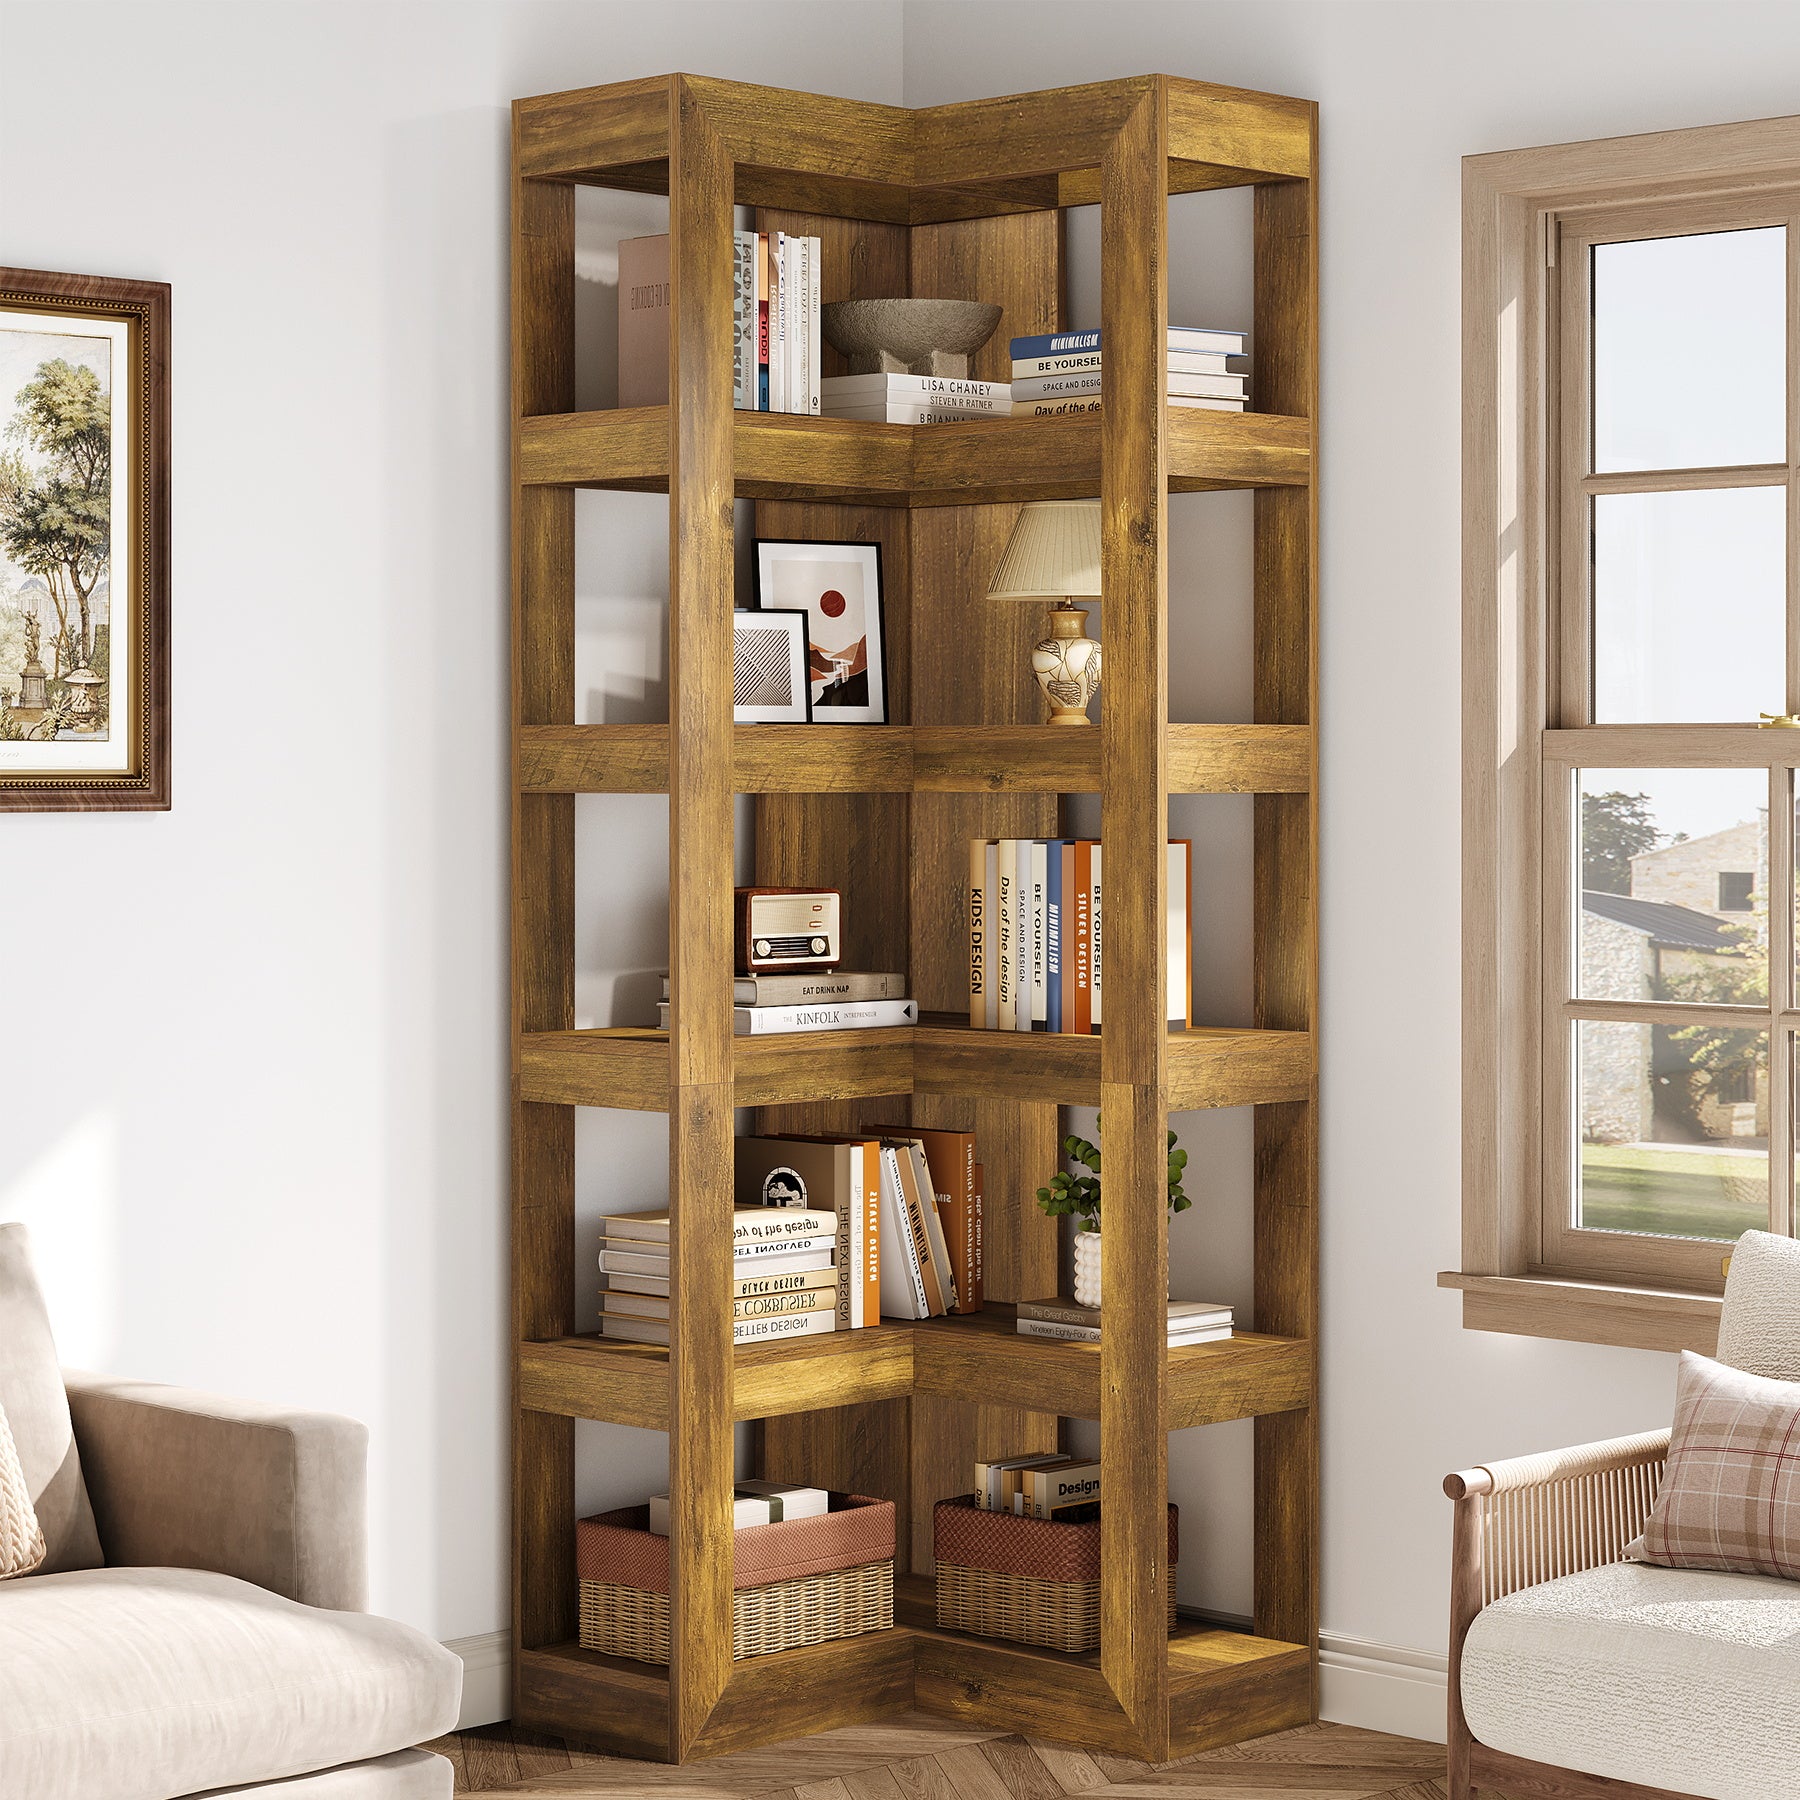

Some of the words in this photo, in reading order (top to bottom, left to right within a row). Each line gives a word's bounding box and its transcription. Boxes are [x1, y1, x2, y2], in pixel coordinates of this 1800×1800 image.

[1050, 333, 1099, 351] MINIMALISM
[1038, 361, 1051, 371] BE
[1054, 356, 1102, 369] YOURSEL
[921, 378, 945, 392] LISA
[950, 381, 992, 396] CHANEY
[1042, 382, 1063, 392] SPACE
[1065, 381, 1079, 390] AND
[1081, 378, 1102, 388] DESIG
[930, 395, 958, 407] STEVEN
[960, 398, 965, 408] R
[966, 399, 993, 410] RATNER
[1035, 406, 1053, 416] Day
[1056, 403, 1068, 414] of
[1069, 402, 1085, 413] the
[1000, 876, 1010, 904] Day
[1034, 883, 1041, 903] BE
[1094, 886, 1101, 905] BE
[971, 888, 982, 927] KIDS
[1078, 893, 1086, 936] SILVER
[1001, 909, 1010, 925] of
[1001, 927, 1010, 951] the
[1049, 903, 1059, 974] MINIMALISM
[971, 933, 982, 994] DESIGN
[1078, 943, 1086, 988] DESIGN
[1001, 955, 1011, 1003] design
[802, 987, 815, 995] EAT
[816, 986, 835, 994] DRINK
[836, 985, 850, 993] NAP
[796, 1011, 840, 1025] KINFOLK
[1031, 1308, 1042, 1317] The
[1044, 1309, 1062, 1320] Great
[1063, 1311, 1086, 1323] Gatsby
[1029, 1325, 1054, 1335] Nineteen
[1059, 1480, 1100, 1496] Design
